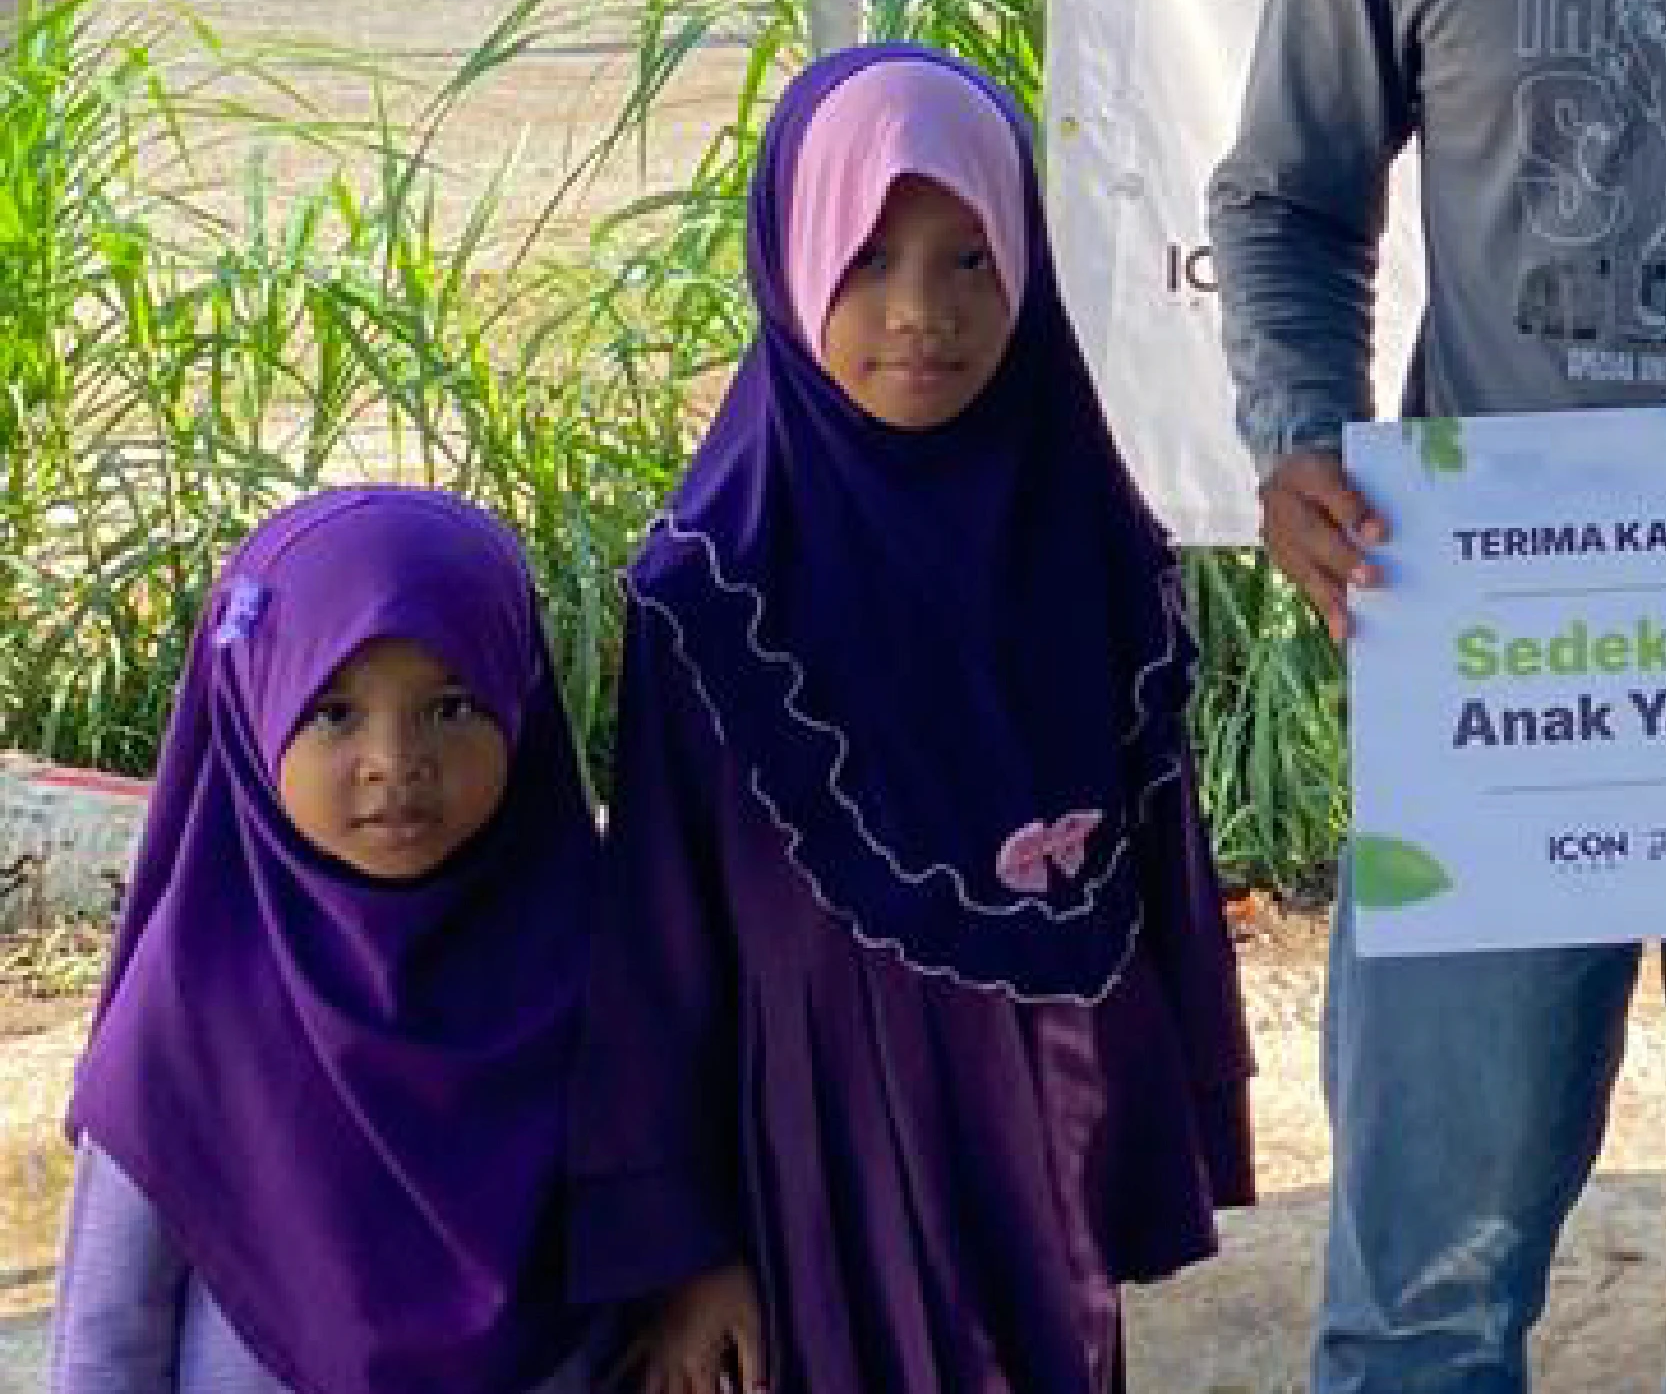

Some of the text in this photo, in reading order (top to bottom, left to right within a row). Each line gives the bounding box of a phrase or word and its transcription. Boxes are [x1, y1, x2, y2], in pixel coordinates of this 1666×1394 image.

[1454, 526, 1605, 560] TERIMA
[1453, 694, 1613, 749] Anak
[1549, 831, 1628, 863] ICON
